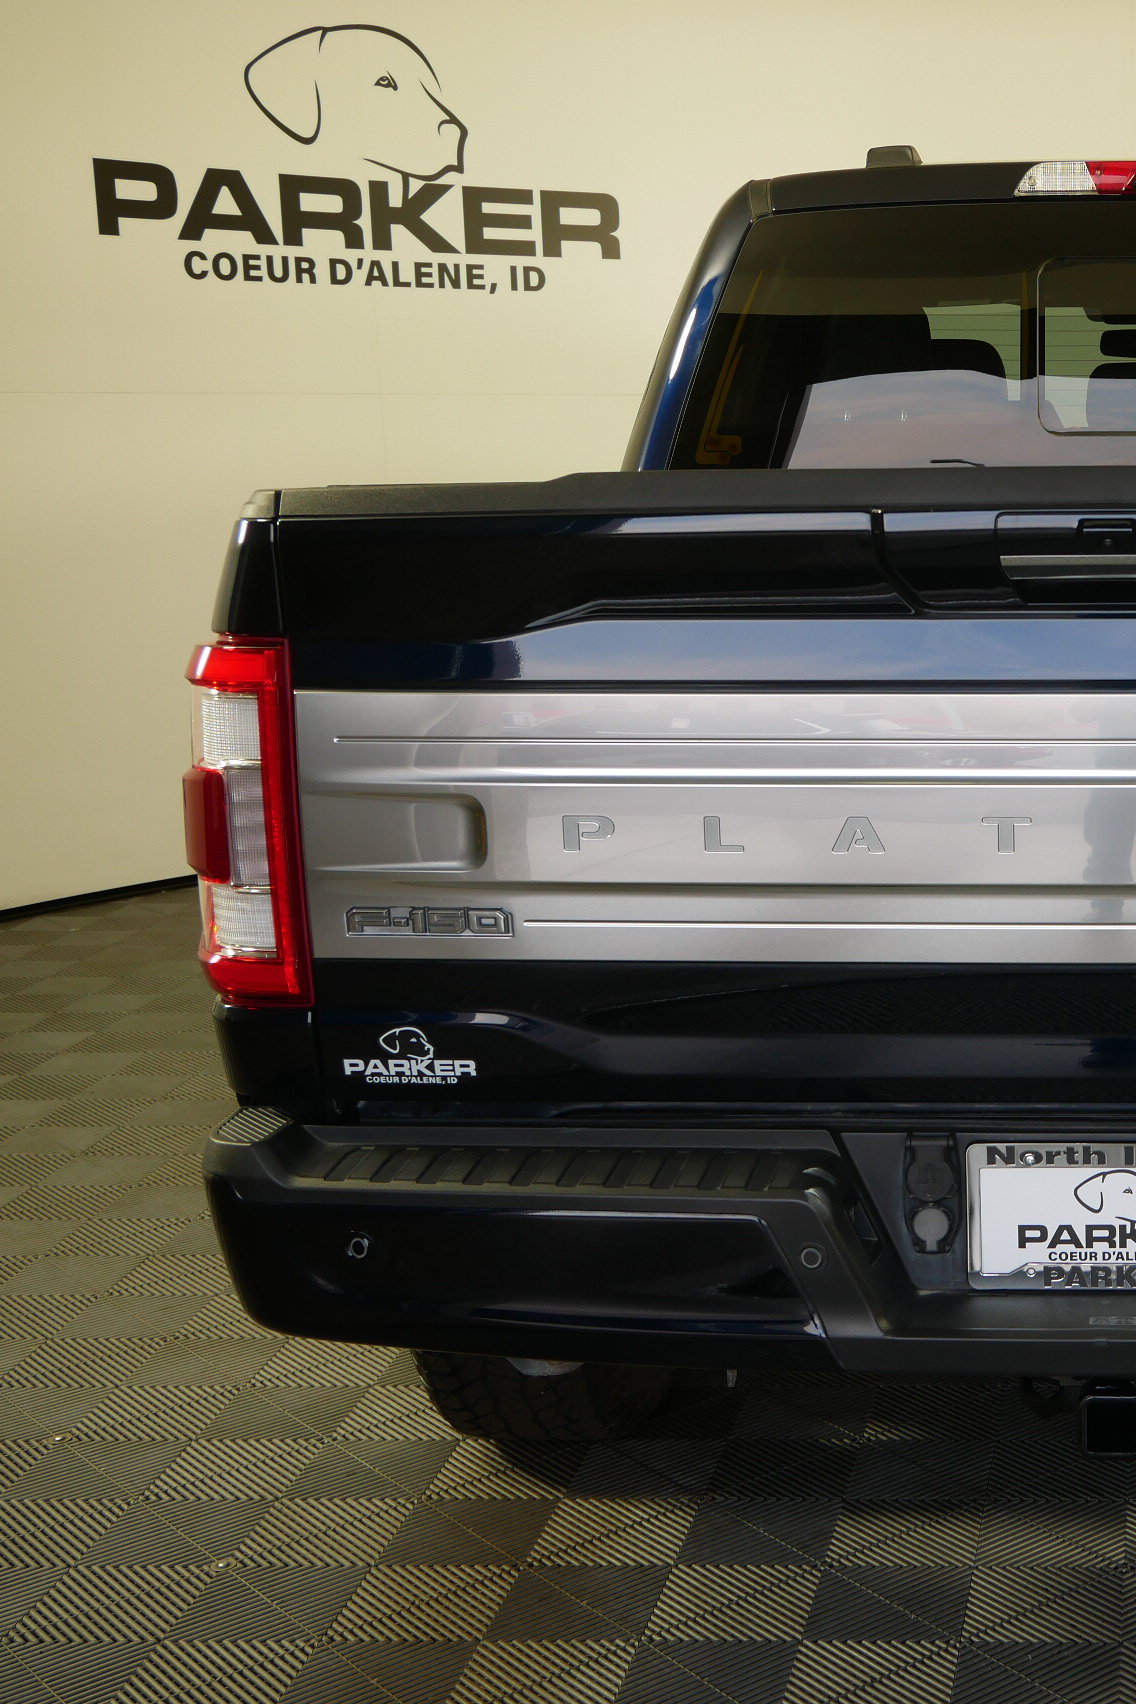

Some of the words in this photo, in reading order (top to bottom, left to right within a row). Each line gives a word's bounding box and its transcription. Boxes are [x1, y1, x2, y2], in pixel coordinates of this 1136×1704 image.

[92, 157, 621, 260] PARKER
[183, 250, 317, 285] COEUR
[328, 257, 498, 294] D'ALENE,
[509, 265, 547, 292] ID
[345, 906, 514, 937] F-150
[342, 1058, 477, 1077] PARKER
[365, 1076, 400, 1084] COEUR
[402, 1076, 446, 1085] D'ALENE,
[447, 1076, 458, 1084] ID
[986, 1145, 1107, 1166] North
[1048, 1251, 1098, 1262] COEUR
